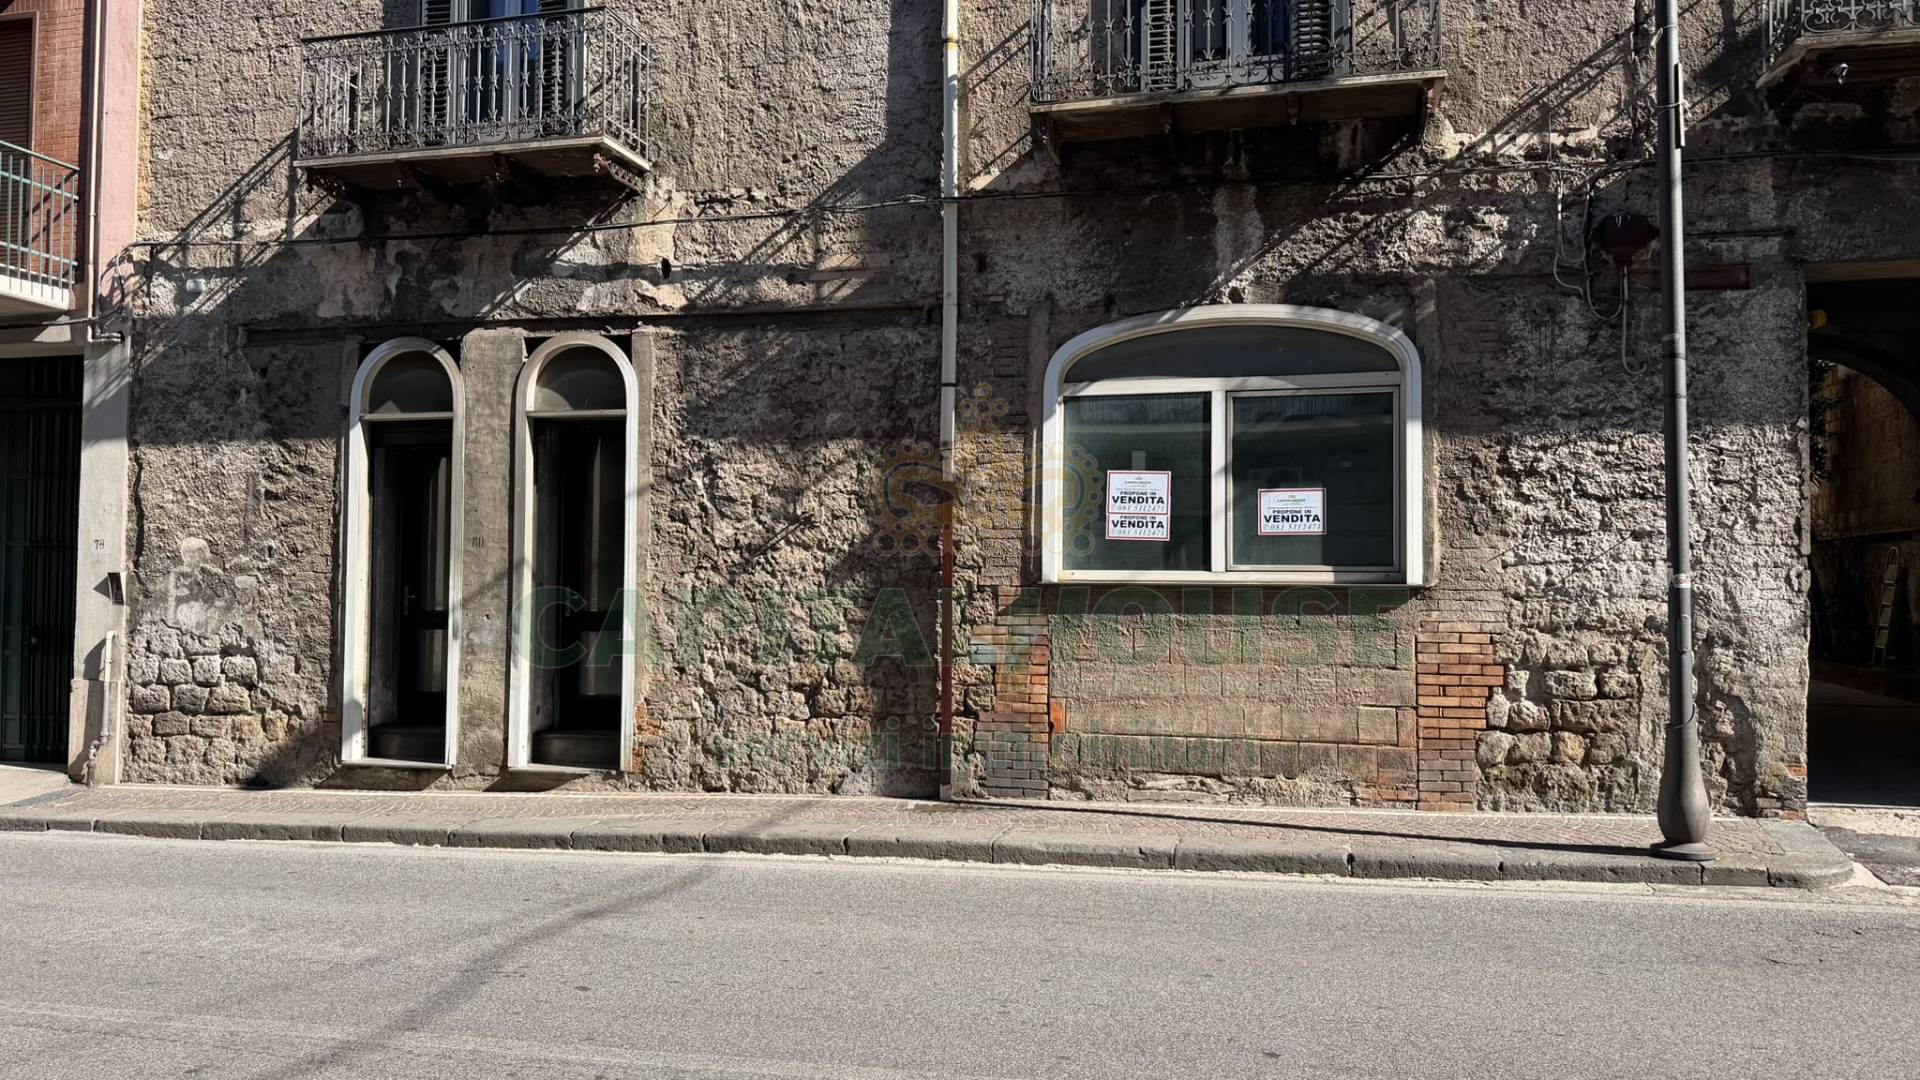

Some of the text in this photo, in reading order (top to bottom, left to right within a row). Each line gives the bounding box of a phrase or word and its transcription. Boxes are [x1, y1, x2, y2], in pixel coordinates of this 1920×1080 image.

[1112, 496, 1164, 504] VENDITA
[1264, 514, 1320, 523] VENDITA
[1112, 520, 1164, 529] VENDITA
[94, 538, 105, 551] 78
